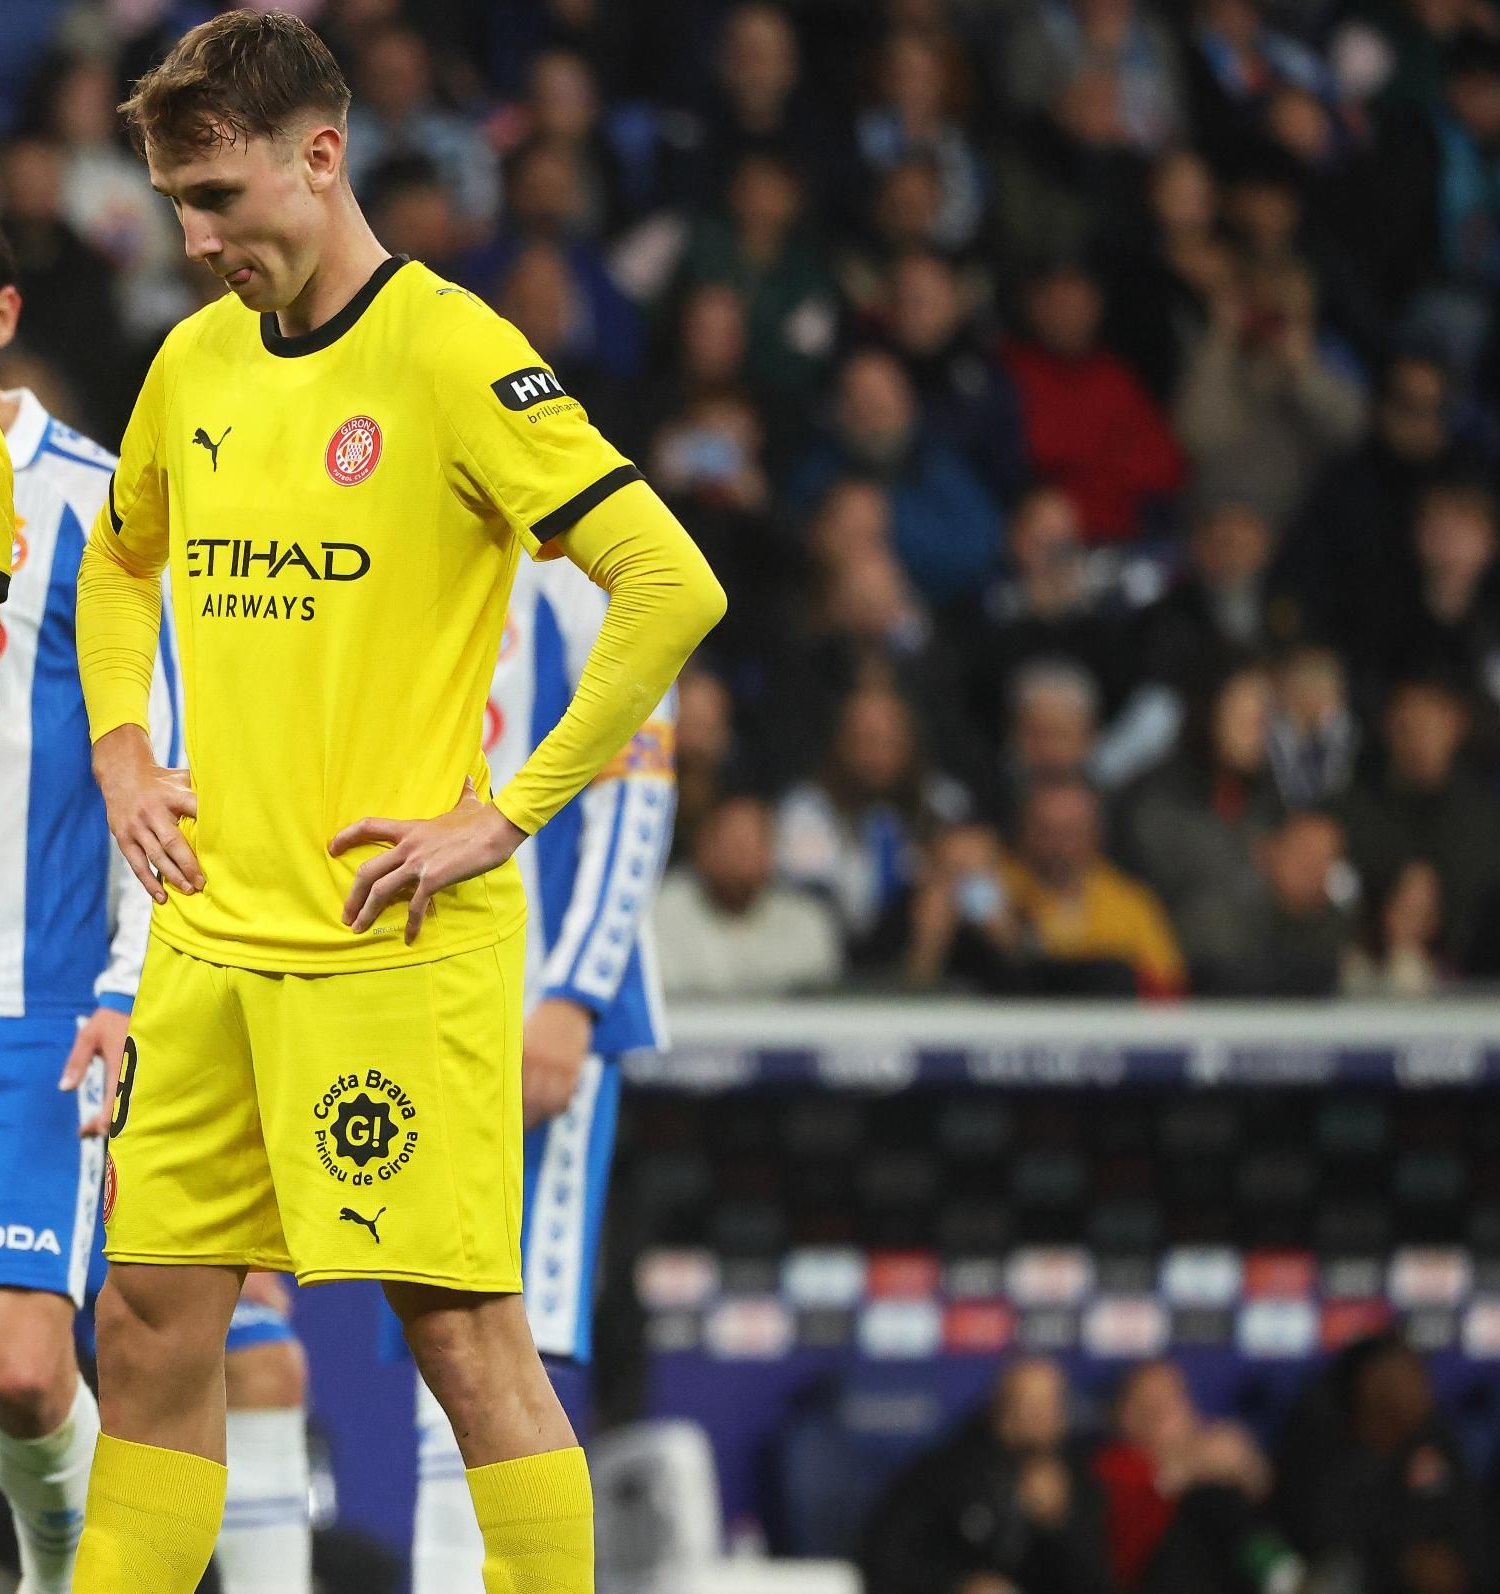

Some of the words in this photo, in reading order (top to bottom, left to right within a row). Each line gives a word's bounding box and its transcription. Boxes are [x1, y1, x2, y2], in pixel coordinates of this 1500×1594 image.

[340, 419, 376, 435] GIRONA
[186, 539, 371, 582] ETIHAD
[201, 593, 316, 621] AIRWAYS
[313, 1074, 359, 1119] Costa
[365, 1069, 416, 1120] Brava
[345, 1115, 381, 1148] G!
[314, 1130, 348, 1182] Pirineu
[352, 1171, 373, 1186] de
[378, 1131, 419, 1181] Girona
